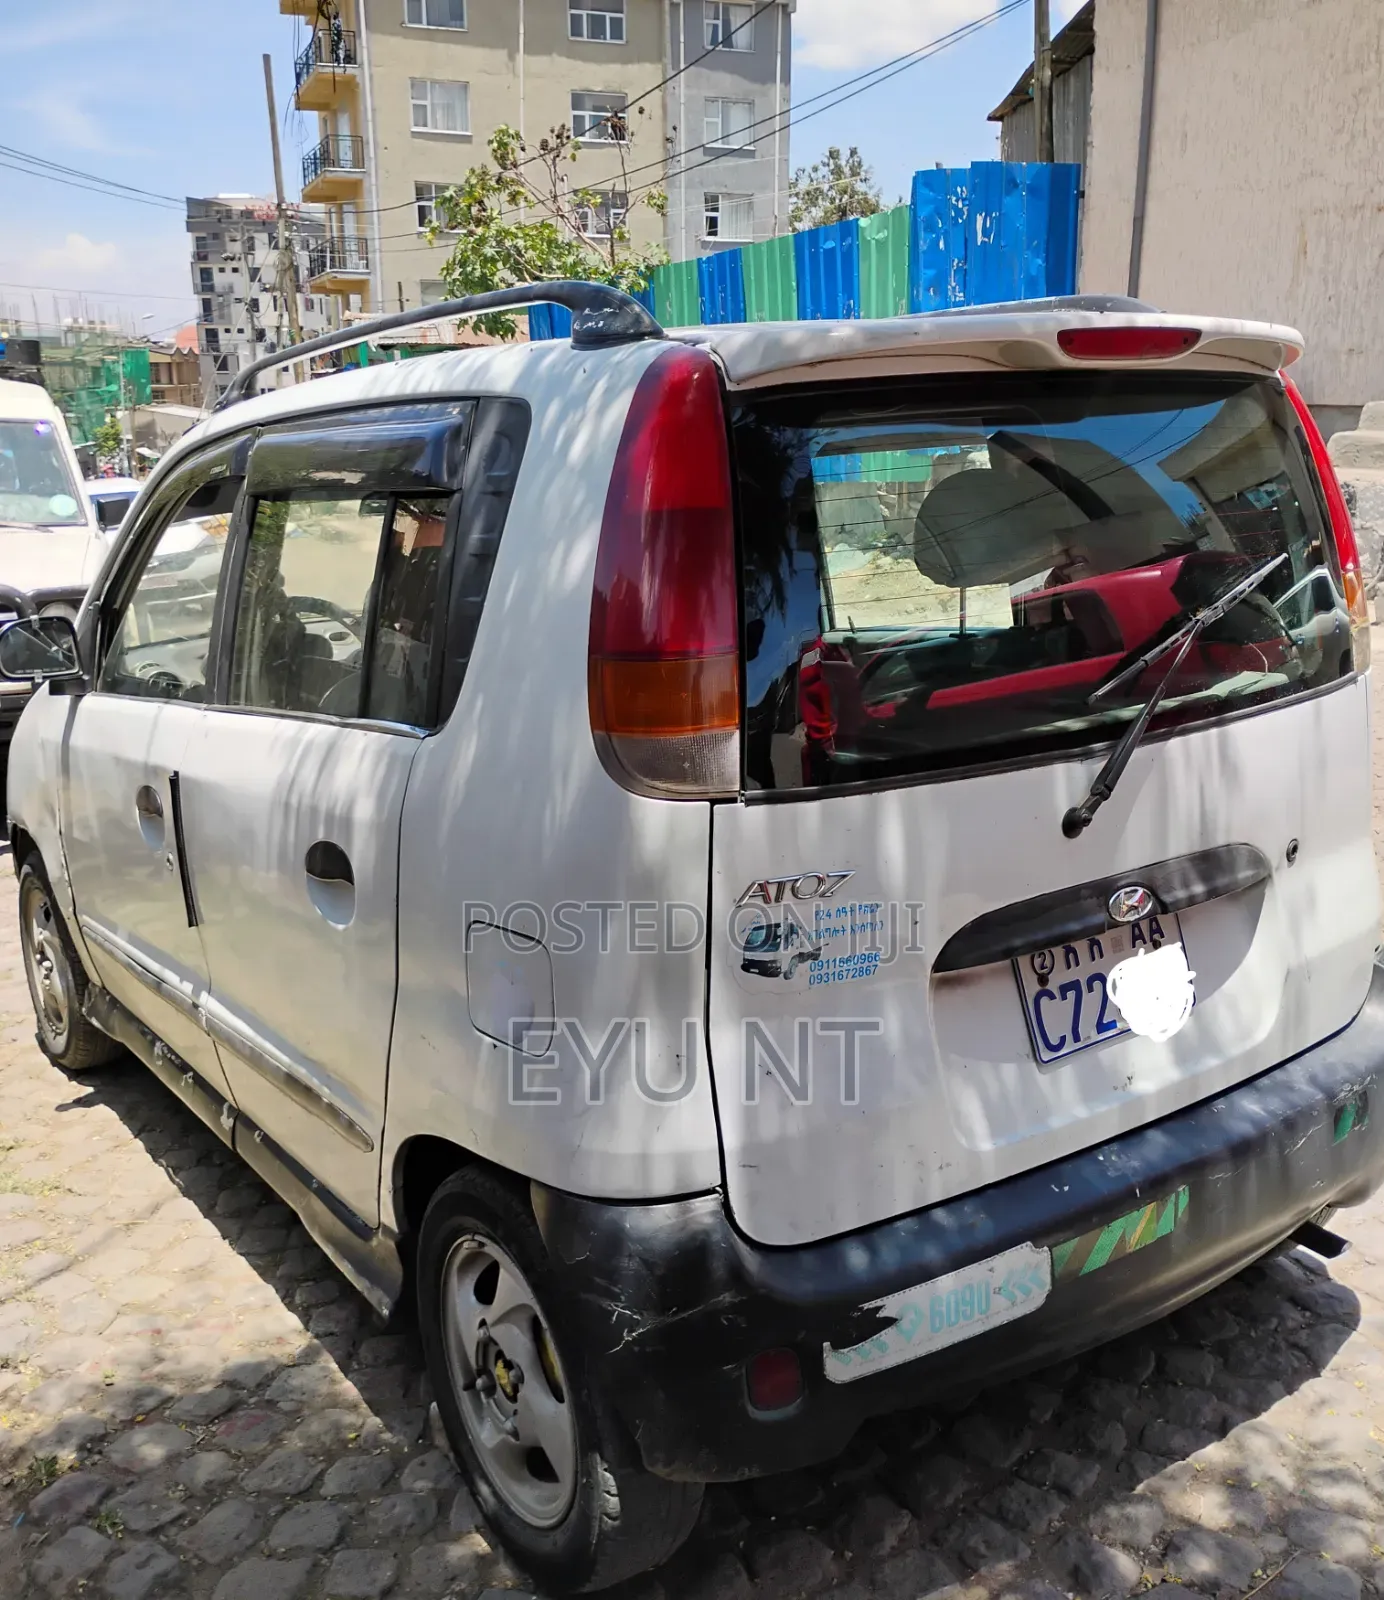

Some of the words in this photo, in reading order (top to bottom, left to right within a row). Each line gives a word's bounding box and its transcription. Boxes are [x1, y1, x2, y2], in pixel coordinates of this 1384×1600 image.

[734, 869, 857, 908] ATOZ
[1131, 916, 1165, 948] AA
[809, 964, 879, 986] 0931672867
[1034, 972, 1118, 1053] C72
